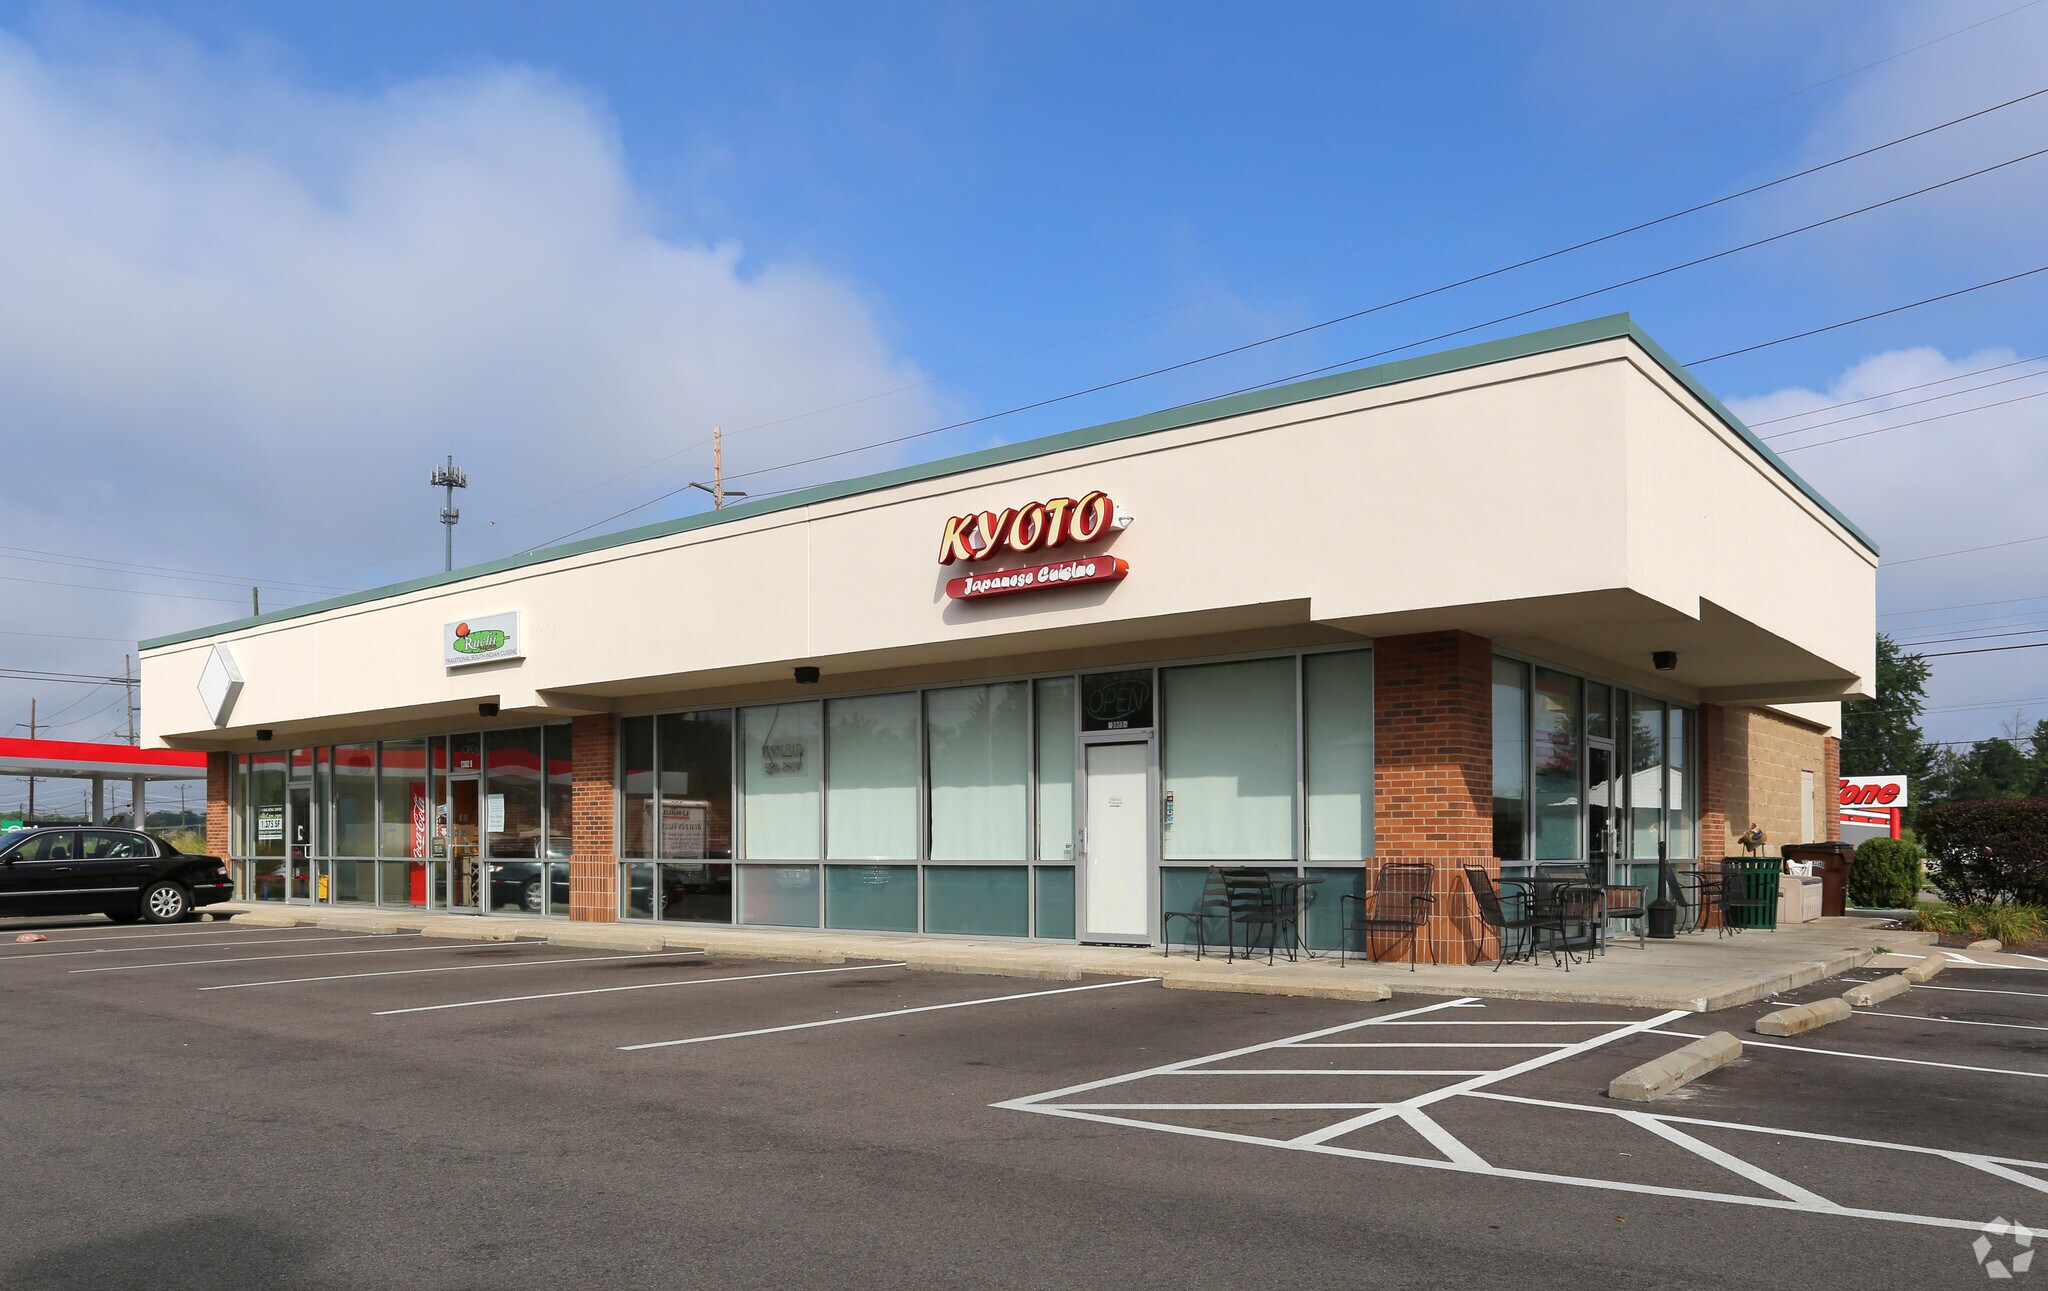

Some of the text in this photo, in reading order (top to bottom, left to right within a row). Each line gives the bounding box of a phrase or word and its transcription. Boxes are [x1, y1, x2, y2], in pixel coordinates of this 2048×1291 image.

[938, 490, 1112, 565] KYOTO
[963, 562, 1096, 595] Japanese Cuisine
[471, 653, 485, 661] SOUTH
[486, 651, 500, 659] INDIAN
[501, 649, 517, 657] CUISINE
[1088, 687, 1143, 713] OPEN
